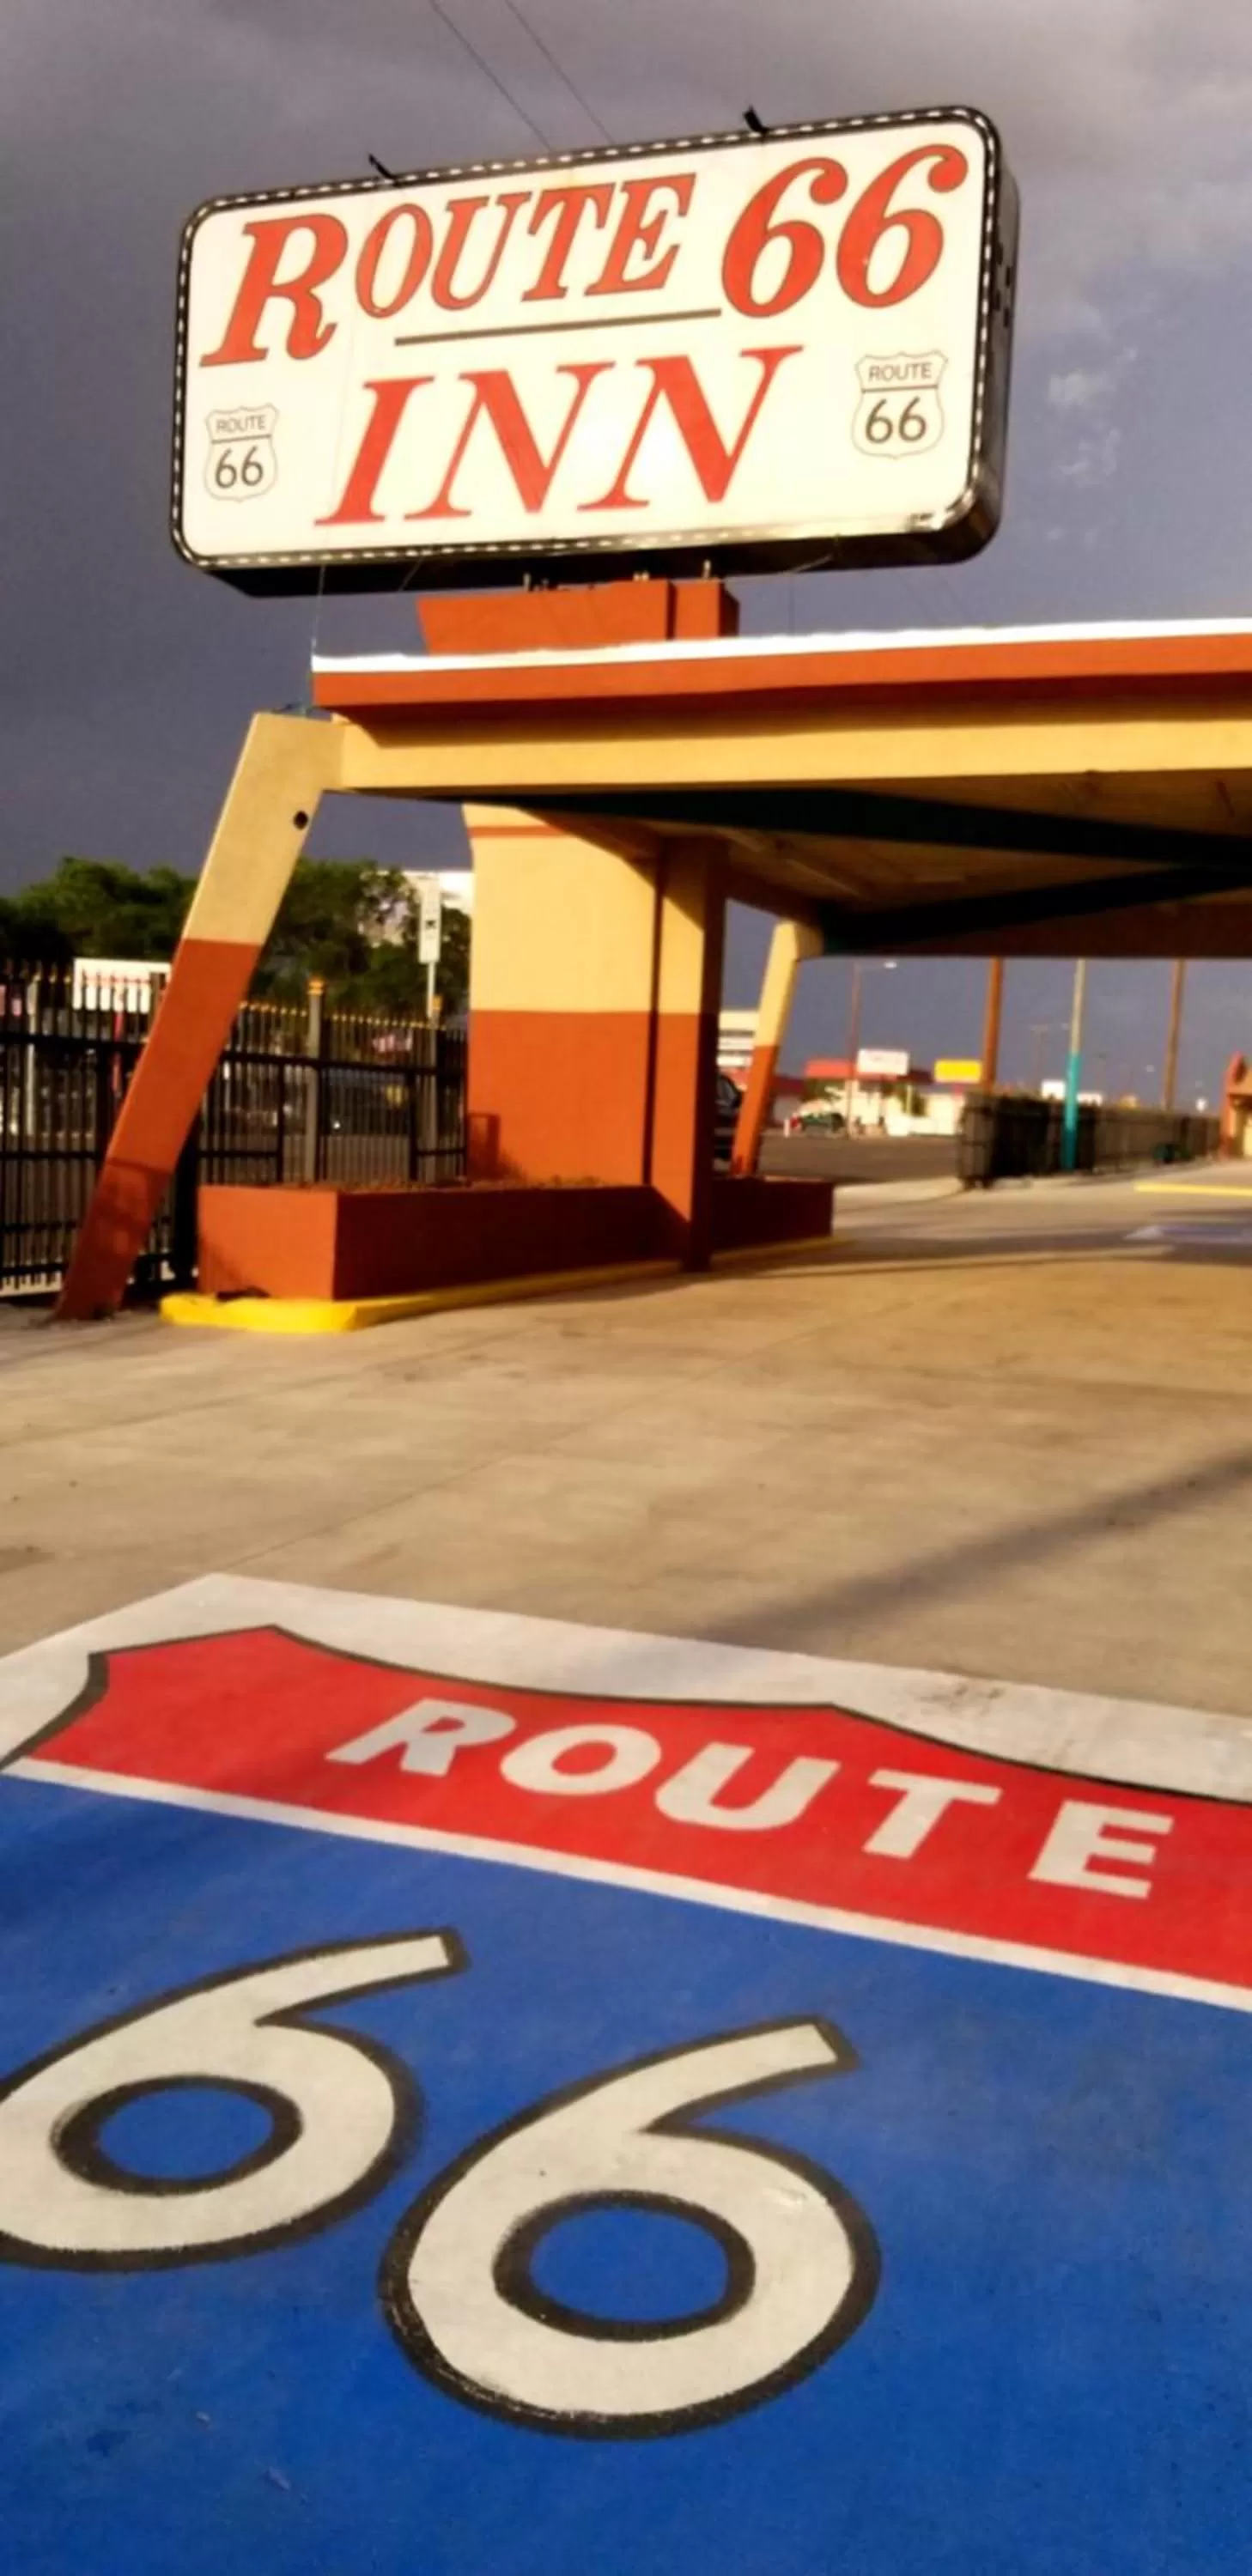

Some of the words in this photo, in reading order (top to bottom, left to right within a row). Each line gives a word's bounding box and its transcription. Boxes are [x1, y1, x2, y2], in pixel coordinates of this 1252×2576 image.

[199, 173, 696, 368] ROUTE
[720, 143, 970, 318] 66
[216, 415, 266, 433] ROUTE
[866, 396, 927, 444] 66
[868, 361, 932, 381] ROUTE
[215, 446, 264, 489] 66
[313, 345, 804, 526] INN
[325, 1697, 1174, 1900] ROUTE
[0, 1926, 882, 2440] 66
